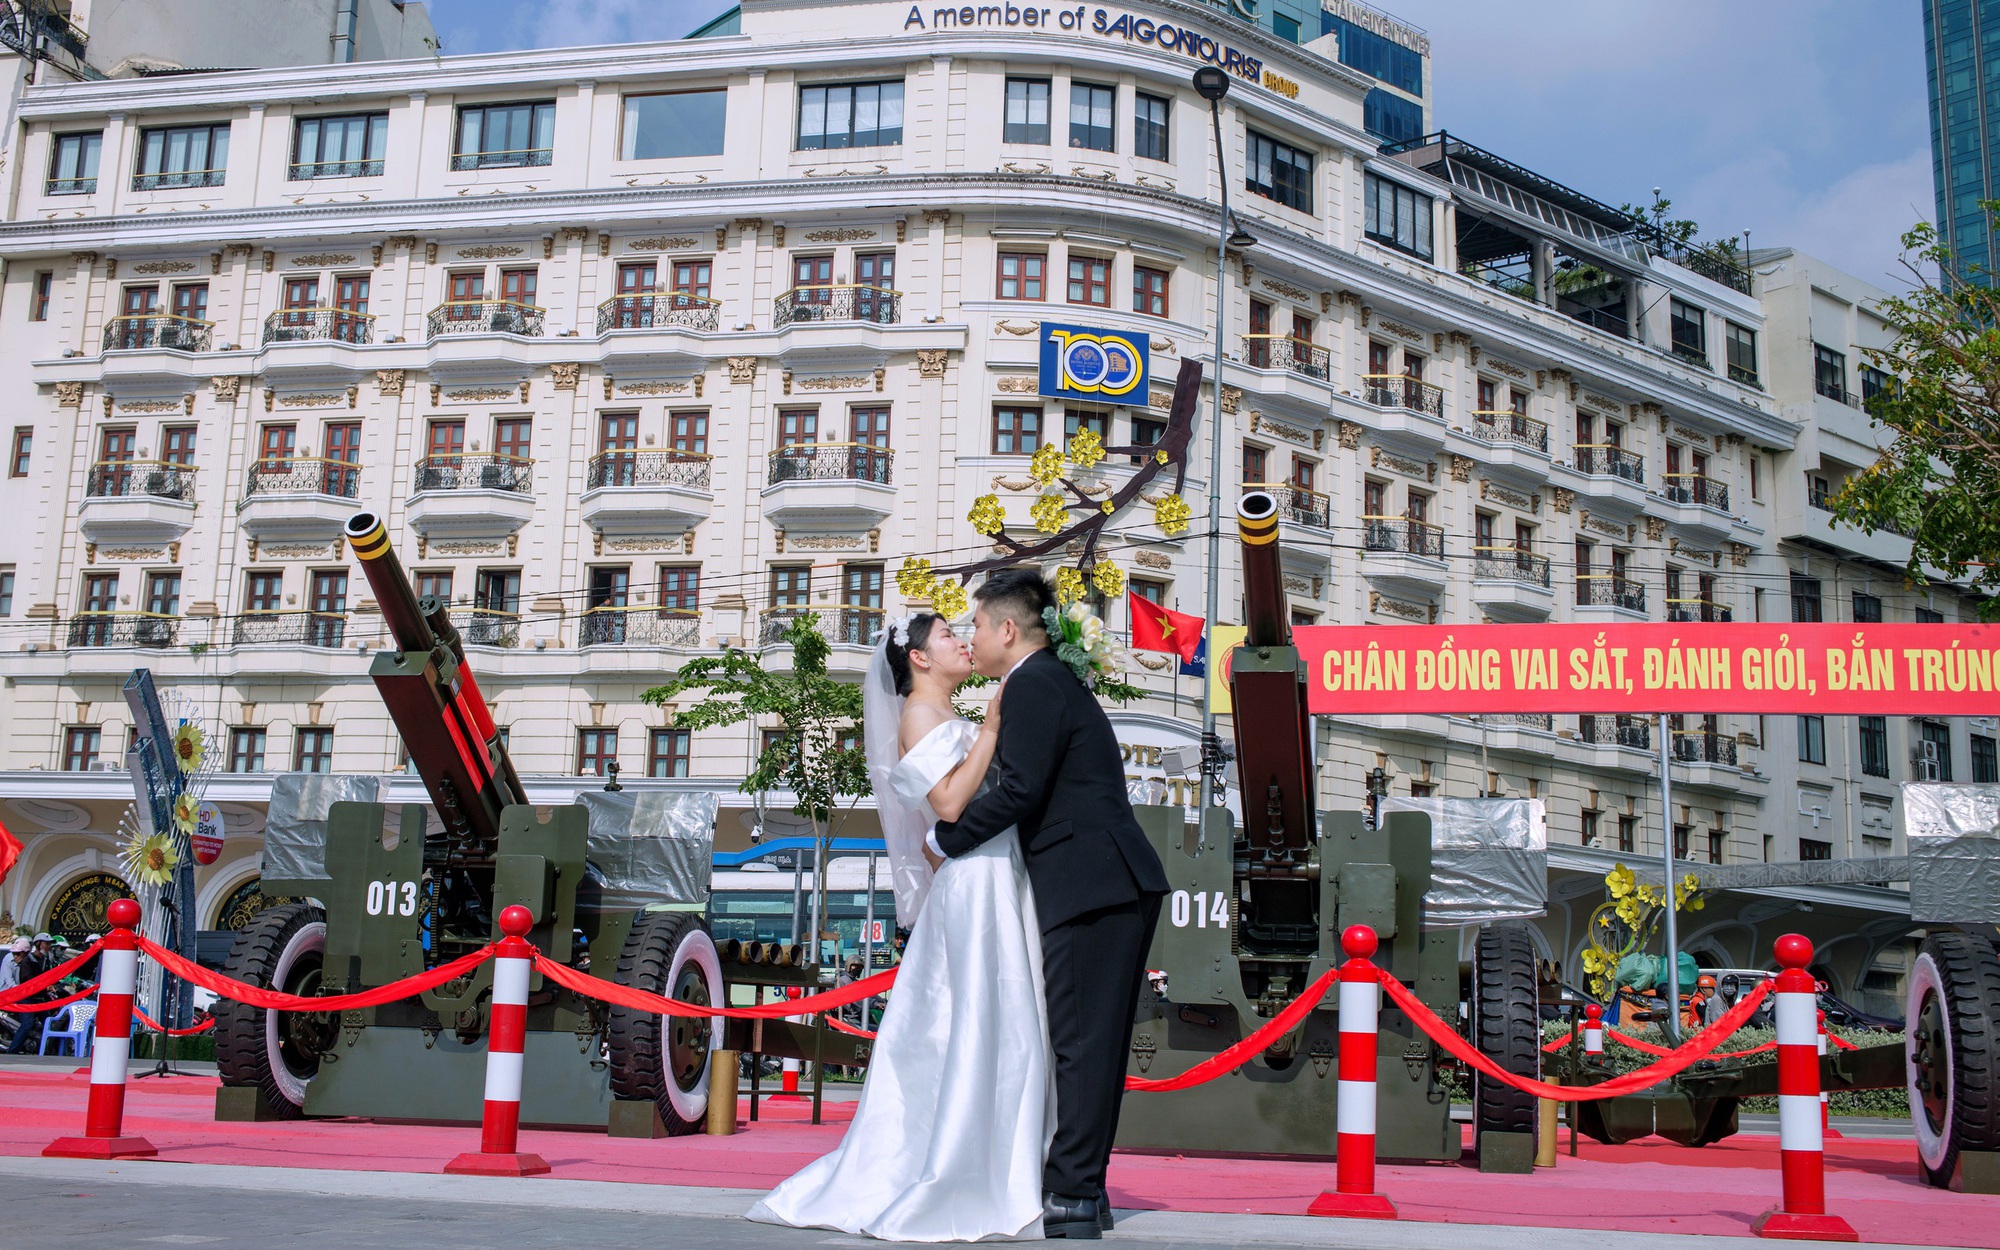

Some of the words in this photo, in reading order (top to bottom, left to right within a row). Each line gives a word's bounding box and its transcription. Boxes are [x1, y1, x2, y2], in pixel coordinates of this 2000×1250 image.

[904, 6, 926, 30] A
[933, 1, 1050, 27] member
[1059, 6, 1085, 30] of
[1092, 9, 1263, 84] SAIGONTOURIST
[1263, 70, 1300, 99] GROUP
[1395, 25, 1430, 59] TOWER
[1048, 330, 1143, 394] 100
[1323, 641, 1406, 691] CHÂN
[1415, 635, 1501, 691] ĐỒNG
[1510, 648, 1559, 690] VAI
[1569, 631, 1633, 695] SẮT,
[1643, 638, 1731, 690] ĐÁNH
[1741, 633, 1816, 696] GIỎI,
[1826, 632, 1895, 691] BẮN
[198, 822, 217, 836] Bank
[200, 810, 210, 822] HD
[72, 876, 99, 893] LOUNGE
[366, 880, 417, 917] 013
[1171, 889, 1230, 929] 014
